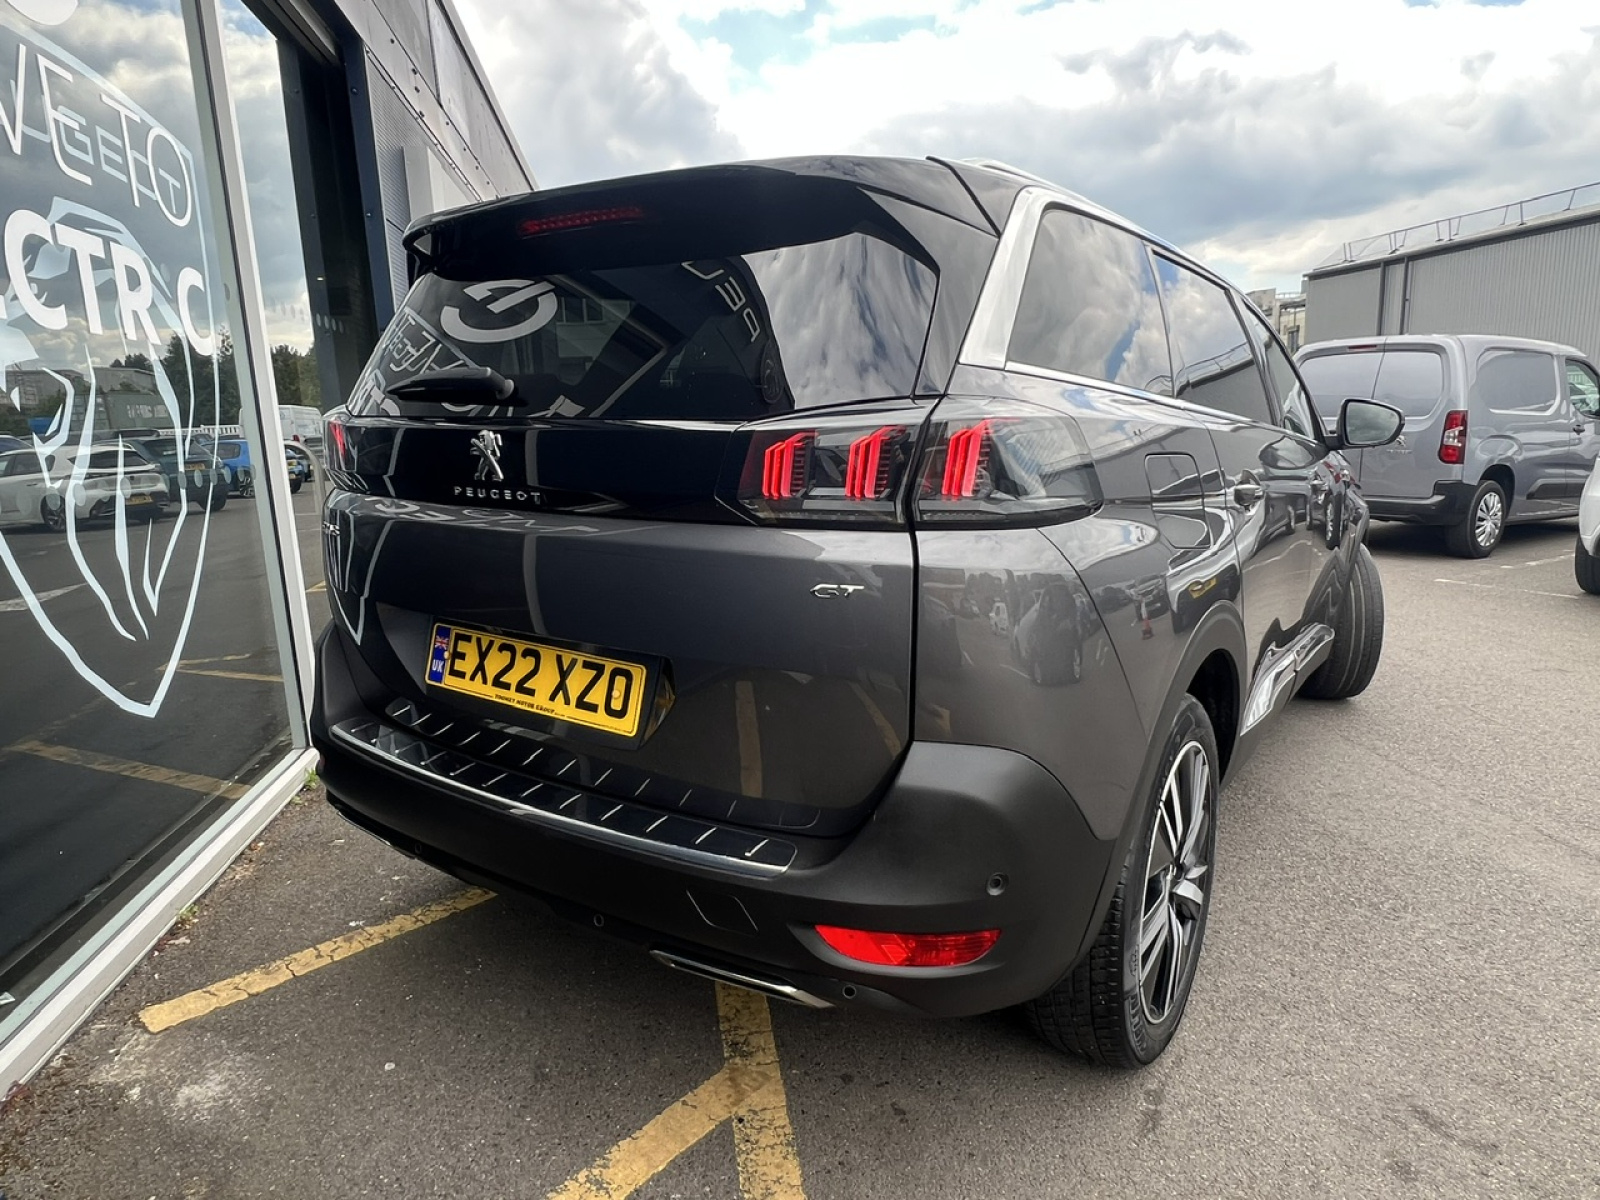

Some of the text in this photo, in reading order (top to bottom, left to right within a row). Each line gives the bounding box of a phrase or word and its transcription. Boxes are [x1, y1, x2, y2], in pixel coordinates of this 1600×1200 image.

[101, 93, 192, 227] TO
[453, 485, 541, 505] PEUGEOT
[810, 584, 865, 598] GT
[431, 659, 444, 673] UK
[448, 633, 633, 719] EX22 XZO
[516, 699, 535, 709] MOTOR
